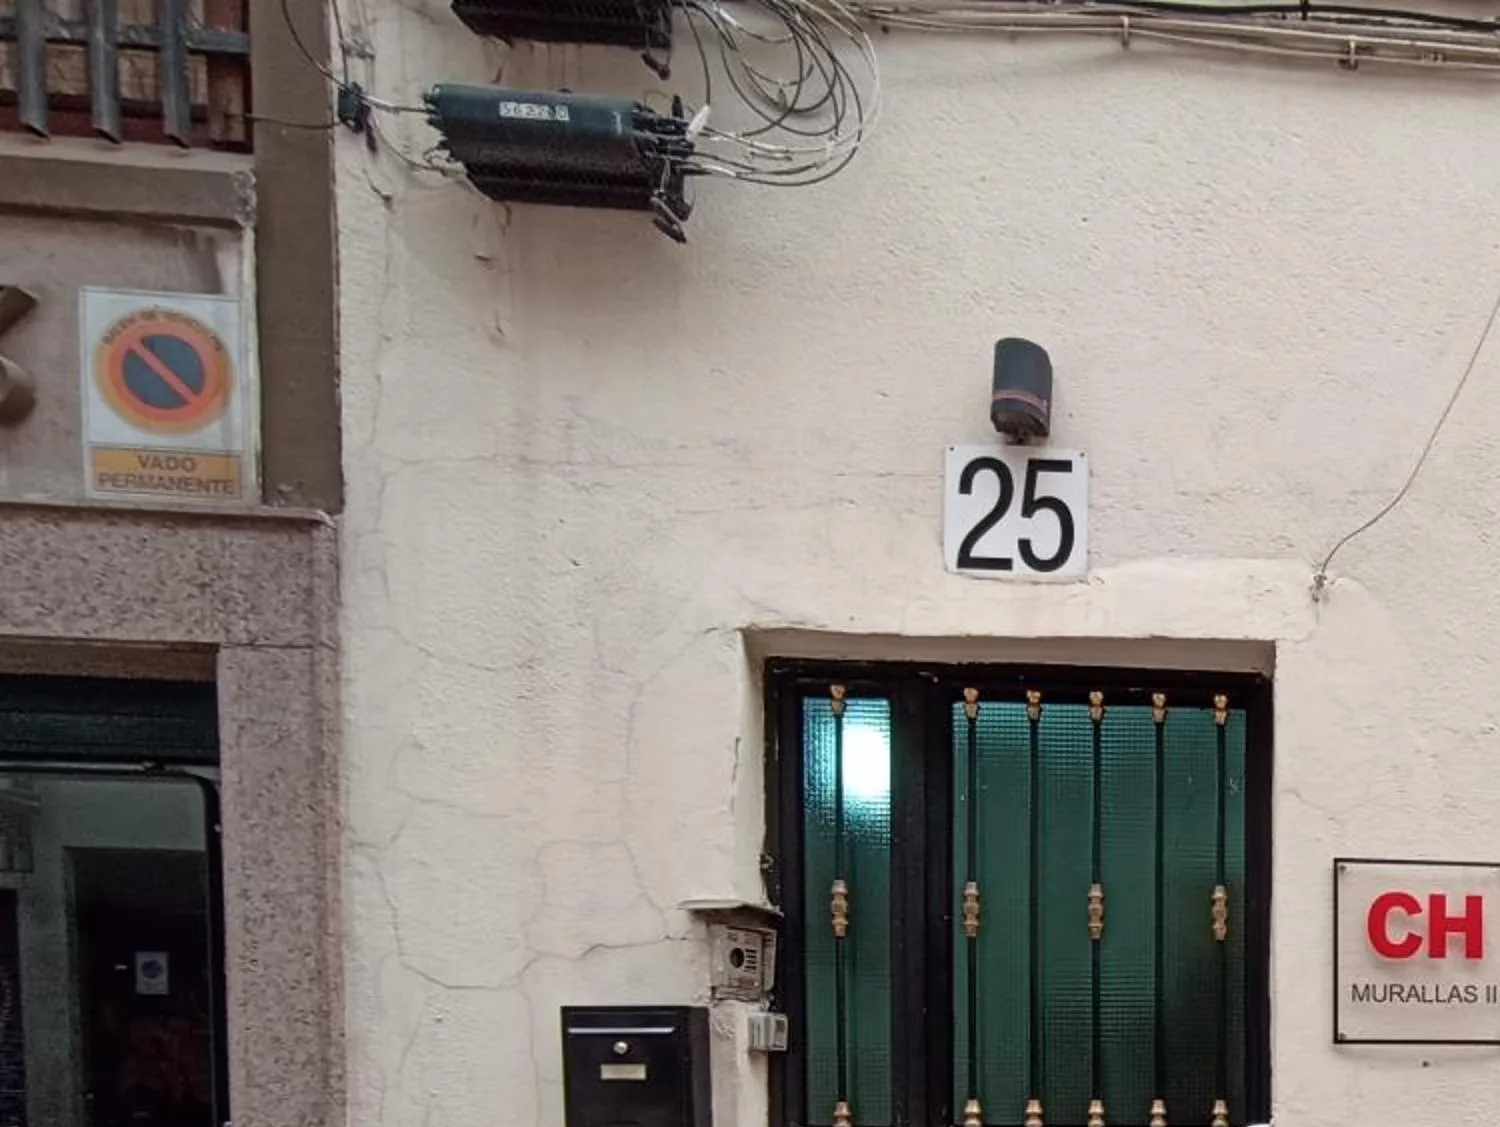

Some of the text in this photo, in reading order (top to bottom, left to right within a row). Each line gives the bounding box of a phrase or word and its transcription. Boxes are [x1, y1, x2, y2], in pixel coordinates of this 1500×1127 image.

[137, 455, 198, 473] VADO
[98, 472, 235, 495] PERMANENTE
[957, 456, 1074, 572] 25
[1367, 891, 1483, 960] CH
[1351, 983, 1498, 1003] MURALLAS II
